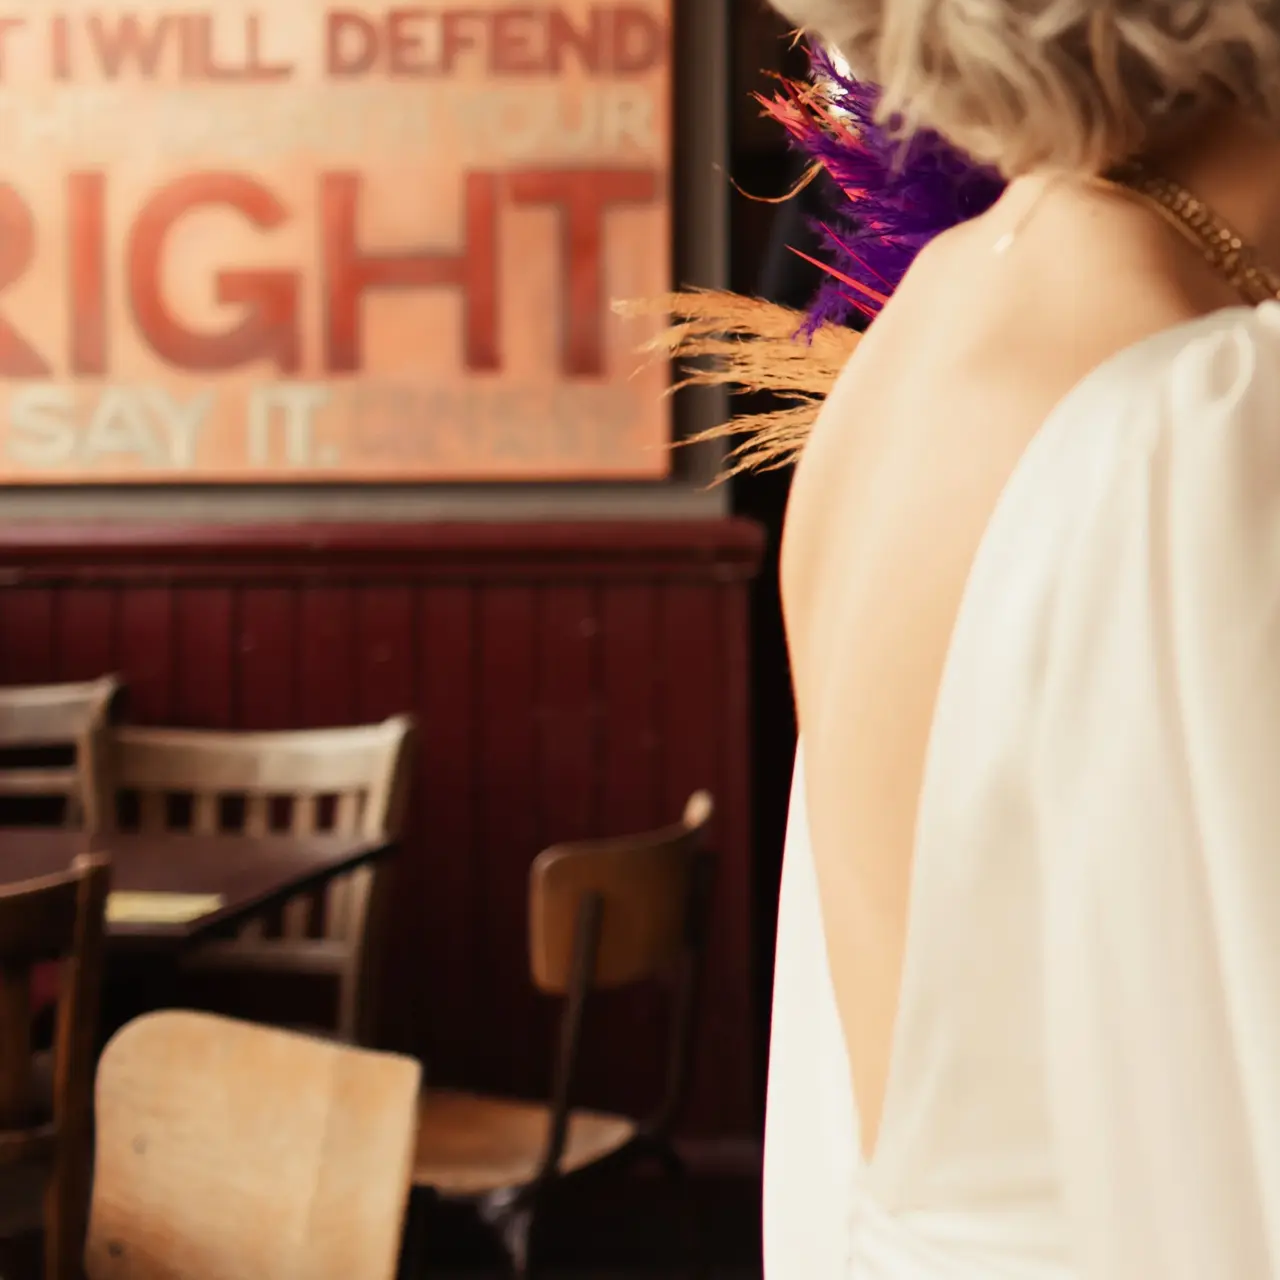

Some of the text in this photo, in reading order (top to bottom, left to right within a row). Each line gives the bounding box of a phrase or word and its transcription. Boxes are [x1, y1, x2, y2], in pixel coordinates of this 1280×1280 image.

[53, 16, 72, 82] I
[85, 14, 293, 82] WILL
[326, 7, 666, 78] DEFEND
[6, 388, 212, 468] SAY
[246, 386, 341, 468] IT.
